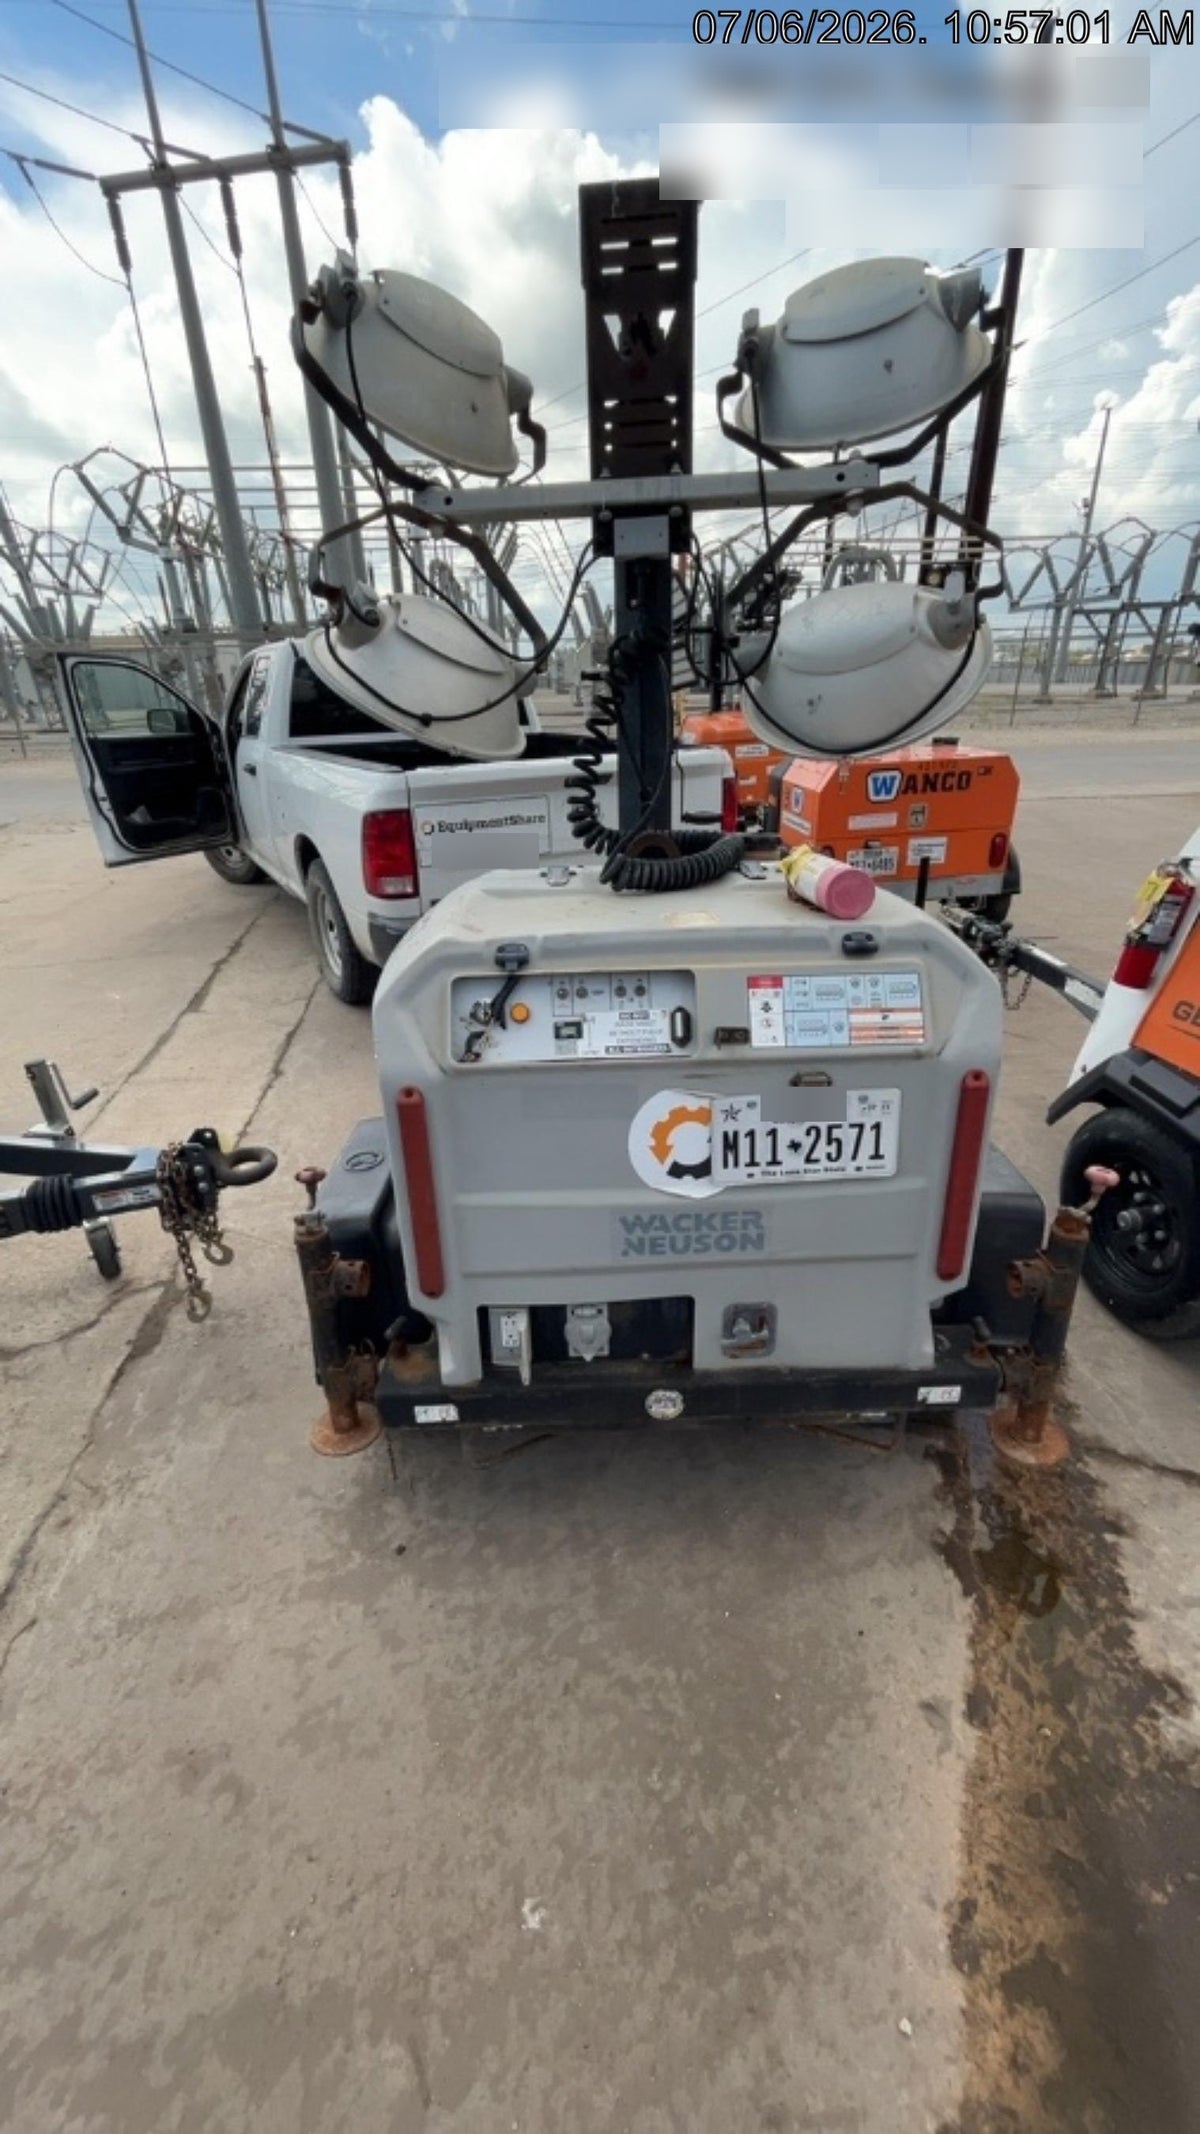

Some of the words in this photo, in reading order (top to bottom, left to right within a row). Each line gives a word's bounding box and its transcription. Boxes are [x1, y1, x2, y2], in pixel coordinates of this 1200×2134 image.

[868, 769, 973, 800] WANCO
[438, 813, 546, 833] EquipmentShare
[619, 1211, 765, 1234] WACKER
[621, 1232, 765, 1258] NEUSON
